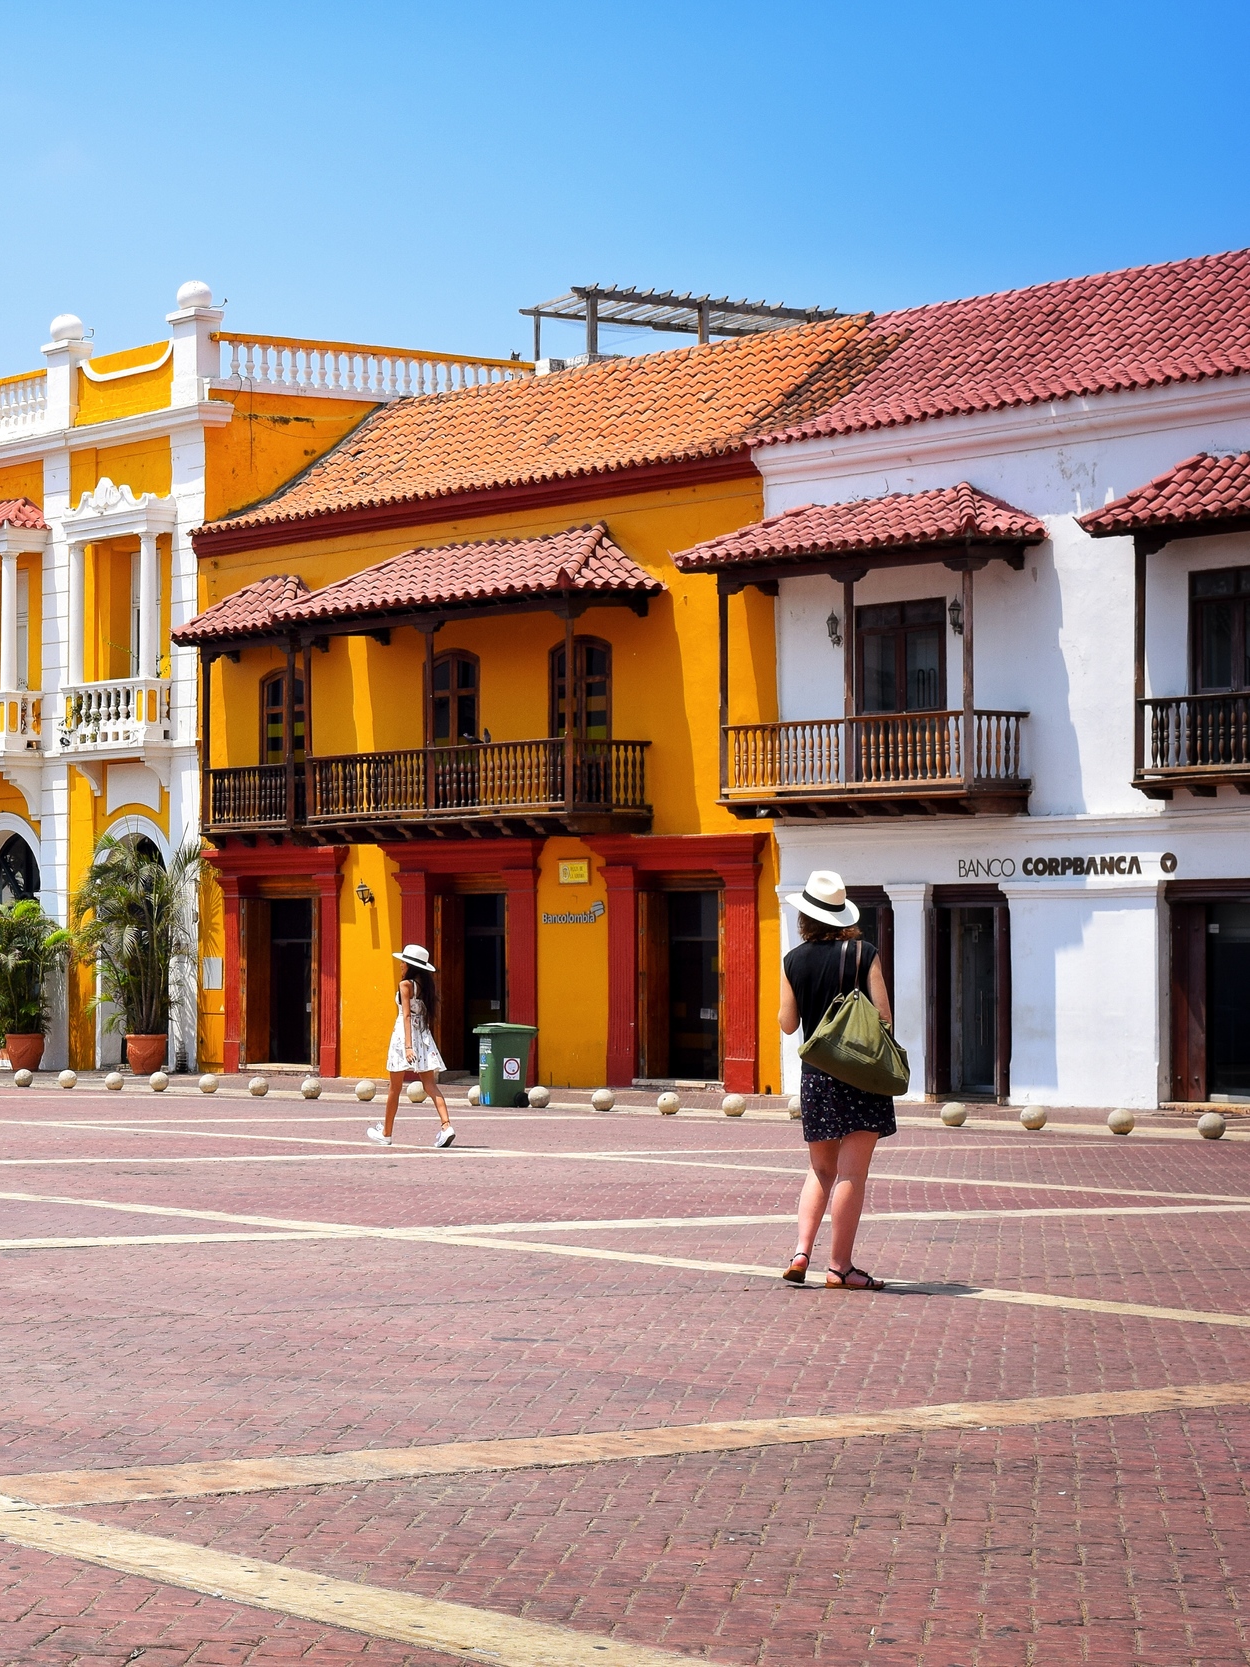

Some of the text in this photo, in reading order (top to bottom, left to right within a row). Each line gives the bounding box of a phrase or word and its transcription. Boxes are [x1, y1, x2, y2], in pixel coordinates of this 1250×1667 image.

[958, 856, 1142, 878] BANCO CORPBANCA
[542, 911, 596, 924] Bancolombia
